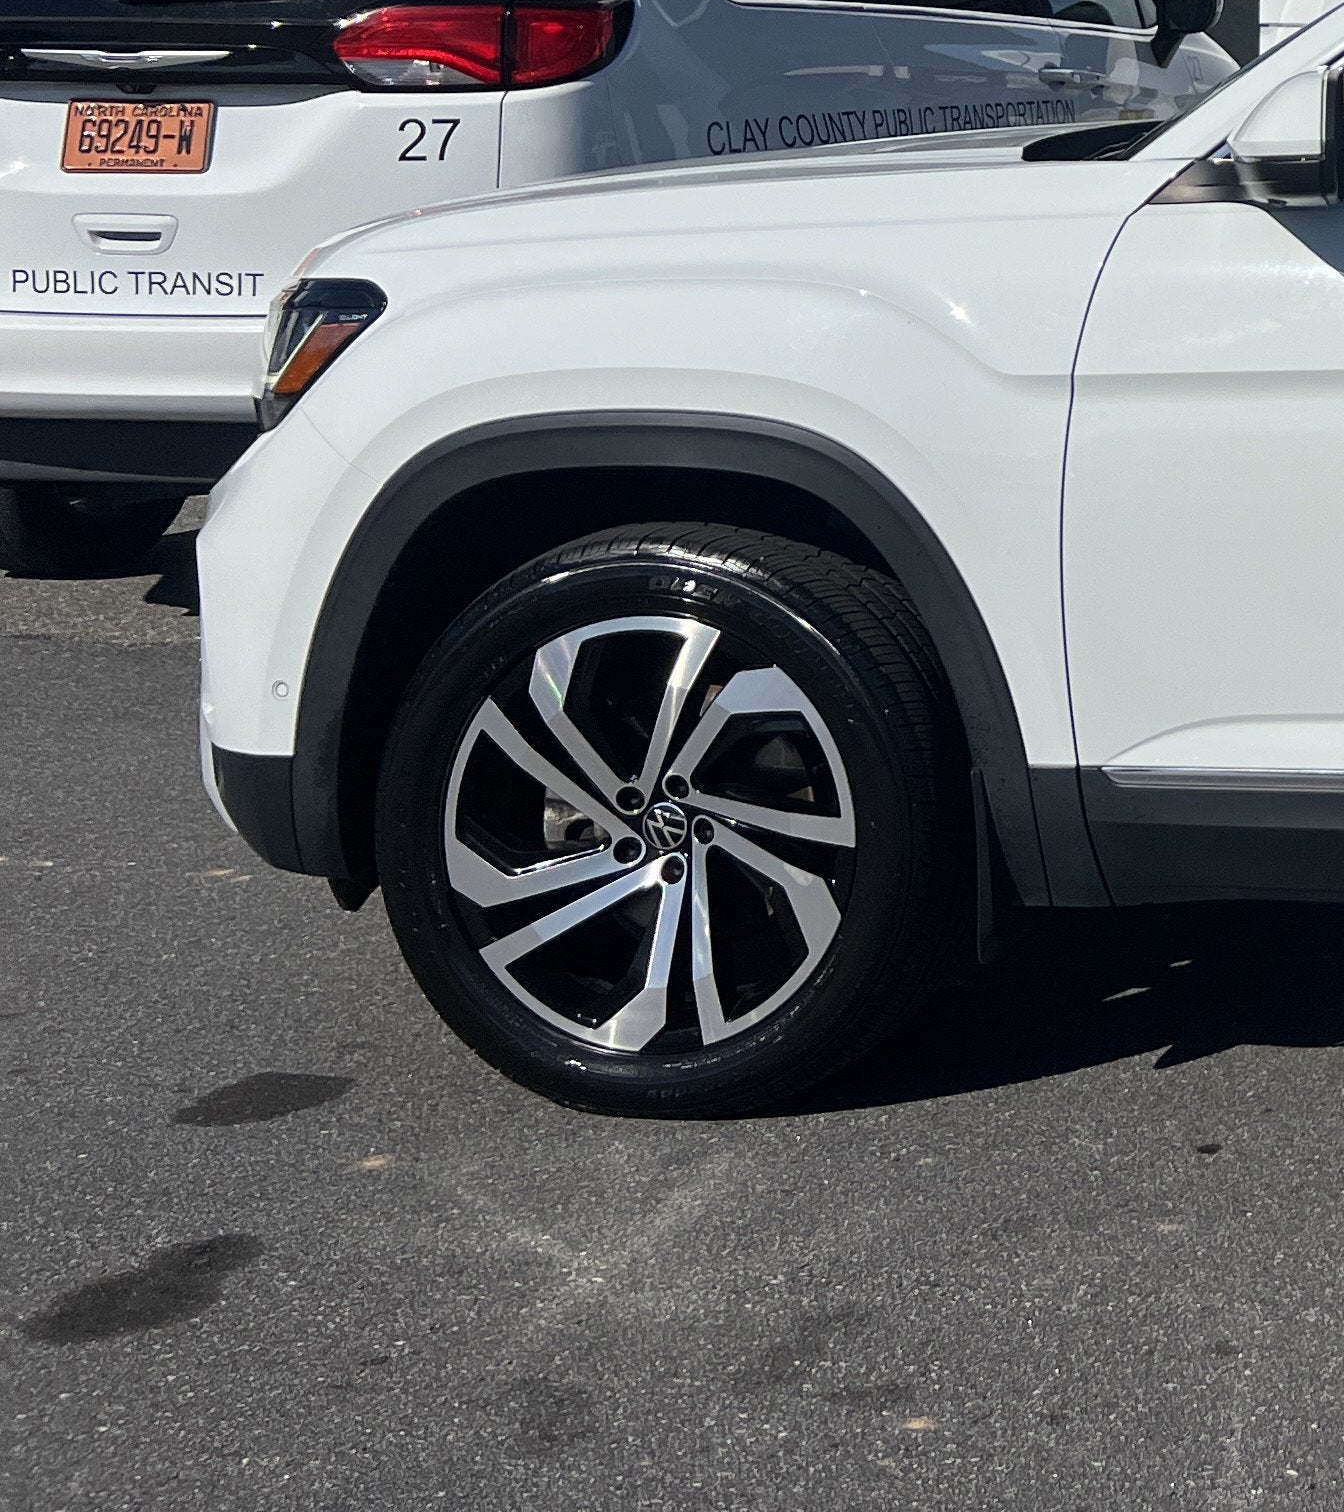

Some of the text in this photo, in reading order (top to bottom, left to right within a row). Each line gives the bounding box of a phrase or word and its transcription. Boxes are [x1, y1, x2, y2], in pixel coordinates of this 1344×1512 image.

[74, 104, 203, 117] NORTH CAROLINA
[78, 117, 195, 155] 69249-W
[398, 118, 461, 161] 27
[707, 99, 1076, 155] CLAY COUNTY PUBLIC TRANSPORTATION
[98, 158, 166, 168] PERMANENT
[12, 269, 264, 296] PUBLIC TRANSIT
